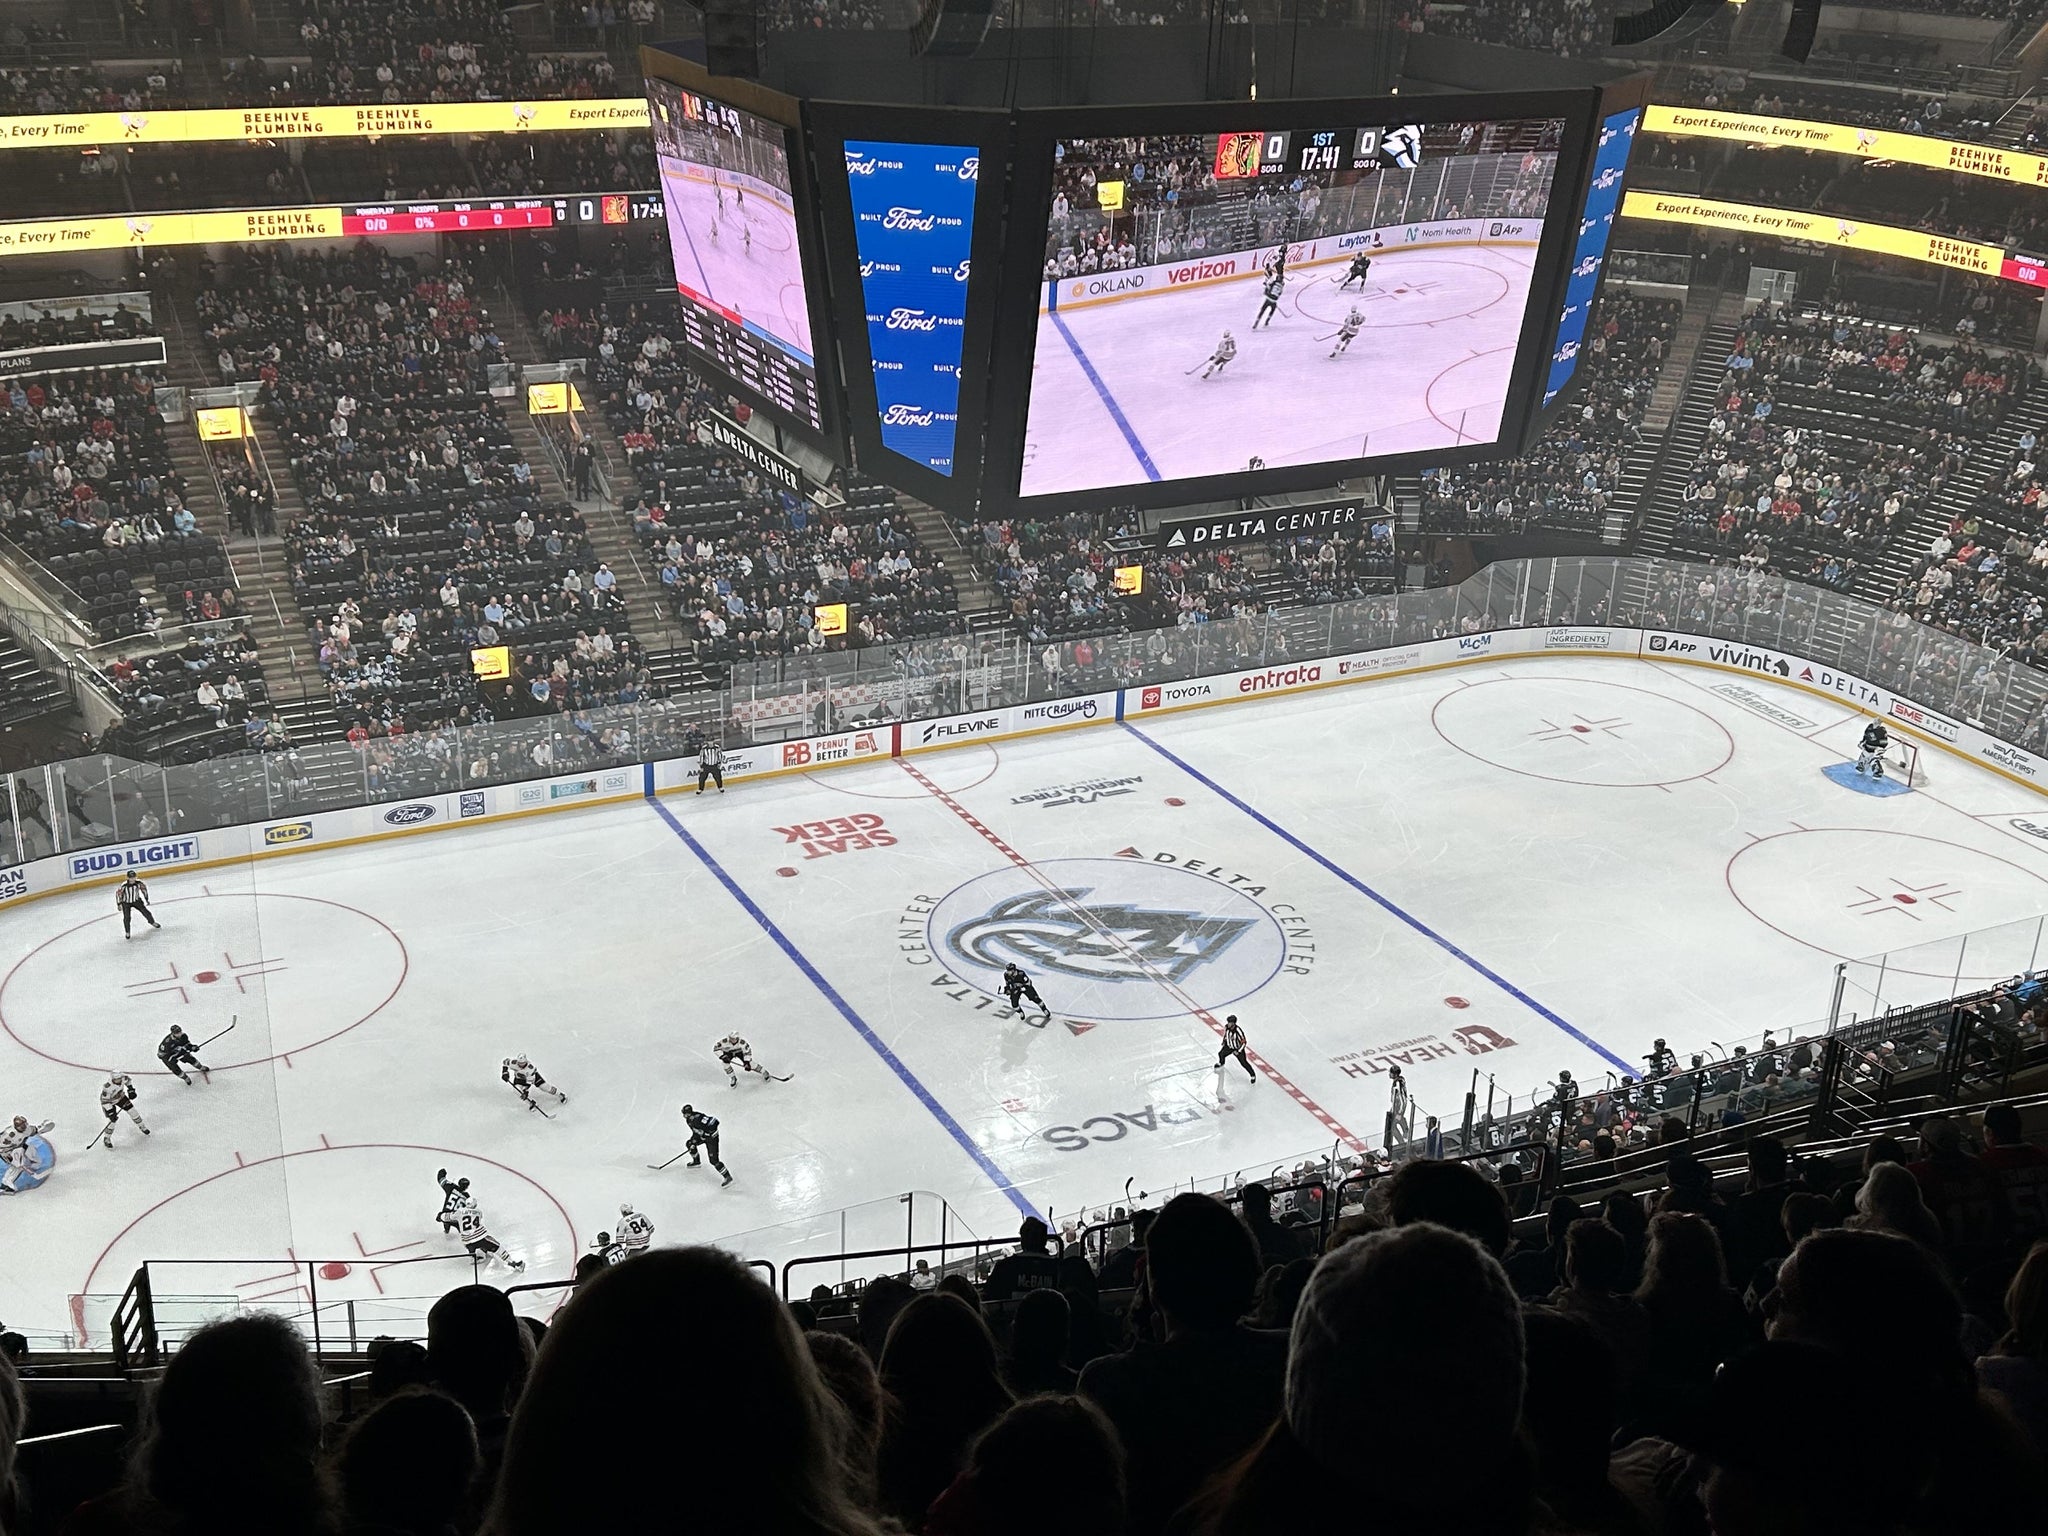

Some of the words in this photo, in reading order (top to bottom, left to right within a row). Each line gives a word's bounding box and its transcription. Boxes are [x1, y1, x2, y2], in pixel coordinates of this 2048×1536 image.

[244, 112, 310, 123] BEEHIVE
[357, 109, 420, 120] BEEHIVE
[570, 108, 606, 120] Expert
[12, 124, 49, 138] Every
[246, 123, 323, 134] PLUMBING
[358, 120, 432, 131] PLUMBING
[1673, 115, 1707, 127] Expert
[1710, 118, 1768, 136] Experience,
[1772, 126, 1802, 139] Every
[1312, 132, 1334, 146] 1ST
[1361, 132, 1376, 154] 0
[1268, 136, 1283, 159] 0
[1951, 146, 2002, 164] BEEHIVE
[877, 161, 904, 170] PROUD
[1301, 146, 1340, 170] 17:41
[1354, 160, 1369, 169] SOG
[935, 164, 956, 173] BUILT
[1261, 165, 1276, 174] SOG
[1950, 158, 2010, 176] PLUMBING
[526, 212, 532, 224] 1
[556, 208, 565, 220] 0
[580, 201, 594, 220] 0
[1656, 202, 1691, 215] Expert
[1692, 206, 1750, 223] Experience,
[1753, 214, 1783, 228] Every
[248, 214, 312, 225] BEEHIVE
[365, 218, 388, 231] 0/0
[414, 217, 434, 228] 0%
[459, 215, 468, 226] 0
[494, 213, 502, 224] 0
[860, 213, 882, 222] BUILT
[882, 206, 934, 232] Ford
[936, 217, 962, 227] PROUD
[20, 230, 56, 244] Every
[249, 225, 325, 236] PLUMBING
[1338, 232, 1371, 249] Layton
[1930, 240, 1980, 258] BEEHIVE
[876, 263, 901, 272] PROUD
[1928, 250, 1988, 270] PLUMBING
[932, 266, 952, 274] BUILT
[1168, 258, 1236, 284] verizon
[2018, 266, 2036, 280] 0/0
[1090, 274, 1144, 296] OKLAND
[886, 307, 936, 332] Ford
[938, 317, 963, 326] PROUD
[0, 356, 32, 369] PLANS
[878, 362, 903, 370] PROUD
[934, 364, 954, 373] BUILT
[884, 404, 932, 427] Ford
[722, 425, 756, 463] DELTA
[757, 451, 798, 491] CENTER
[930, 458, 950, 466] BUILT
[1193, 518, 1266, 543] DELTA
[1275, 506, 1356, 532] CENTER
[1352, 658, 1380, 669] HEALTH
[1708, 643, 1771, 672] vivint
[1239, 664, 1321, 692] entrata
[1166, 685, 1211, 700] TOYOTA
[1822, 672, 1880, 706] DELTA
[1720, 686, 1804, 727] INGREDIENTS
[1894, 704, 1924, 724] SME
[938, 718, 999, 738] FILEVINE
[816, 738, 848, 750] PEANUT
[816, 749, 848, 761] BETTER
[1982, 748, 2014, 766] AMERICA
[2014, 762, 2036, 776] FIRST
[728, 760, 754, 772] FIRST
[606, 776, 624, 786] G2G
[1063, 776, 1142, 794] AMERICA
[522, 789, 541, 798] G2G
[1010, 790, 1062, 805] FIRST
[394, 806, 426, 823] Ford
[269, 826, 308, 840] IKEA
[771, 812, 885, 844] GEEK
[802, 829, 898, 860] SEAT
[74, 854, 121, 874] BUD
[126, 841, 194, 866] LIGHT
[1154, 852, 1268, 898] DELTA
[1270, 903, 1316, 976] CENTER
[898, 894, 941, 966] CENTER
[930, 972, 1052, 1030] DELTA
[1380, 1034, 1438, 1053] UNIVERSITY
[1328, 1052, 1362, 1064] UTAH
[1340, 1042, 1456, 1078] HEALTH
[1364, 1048, 1378, 1057] OF
[462, 1216, 480, 1231] 24
[630, 1218, 649, 1234] 84
